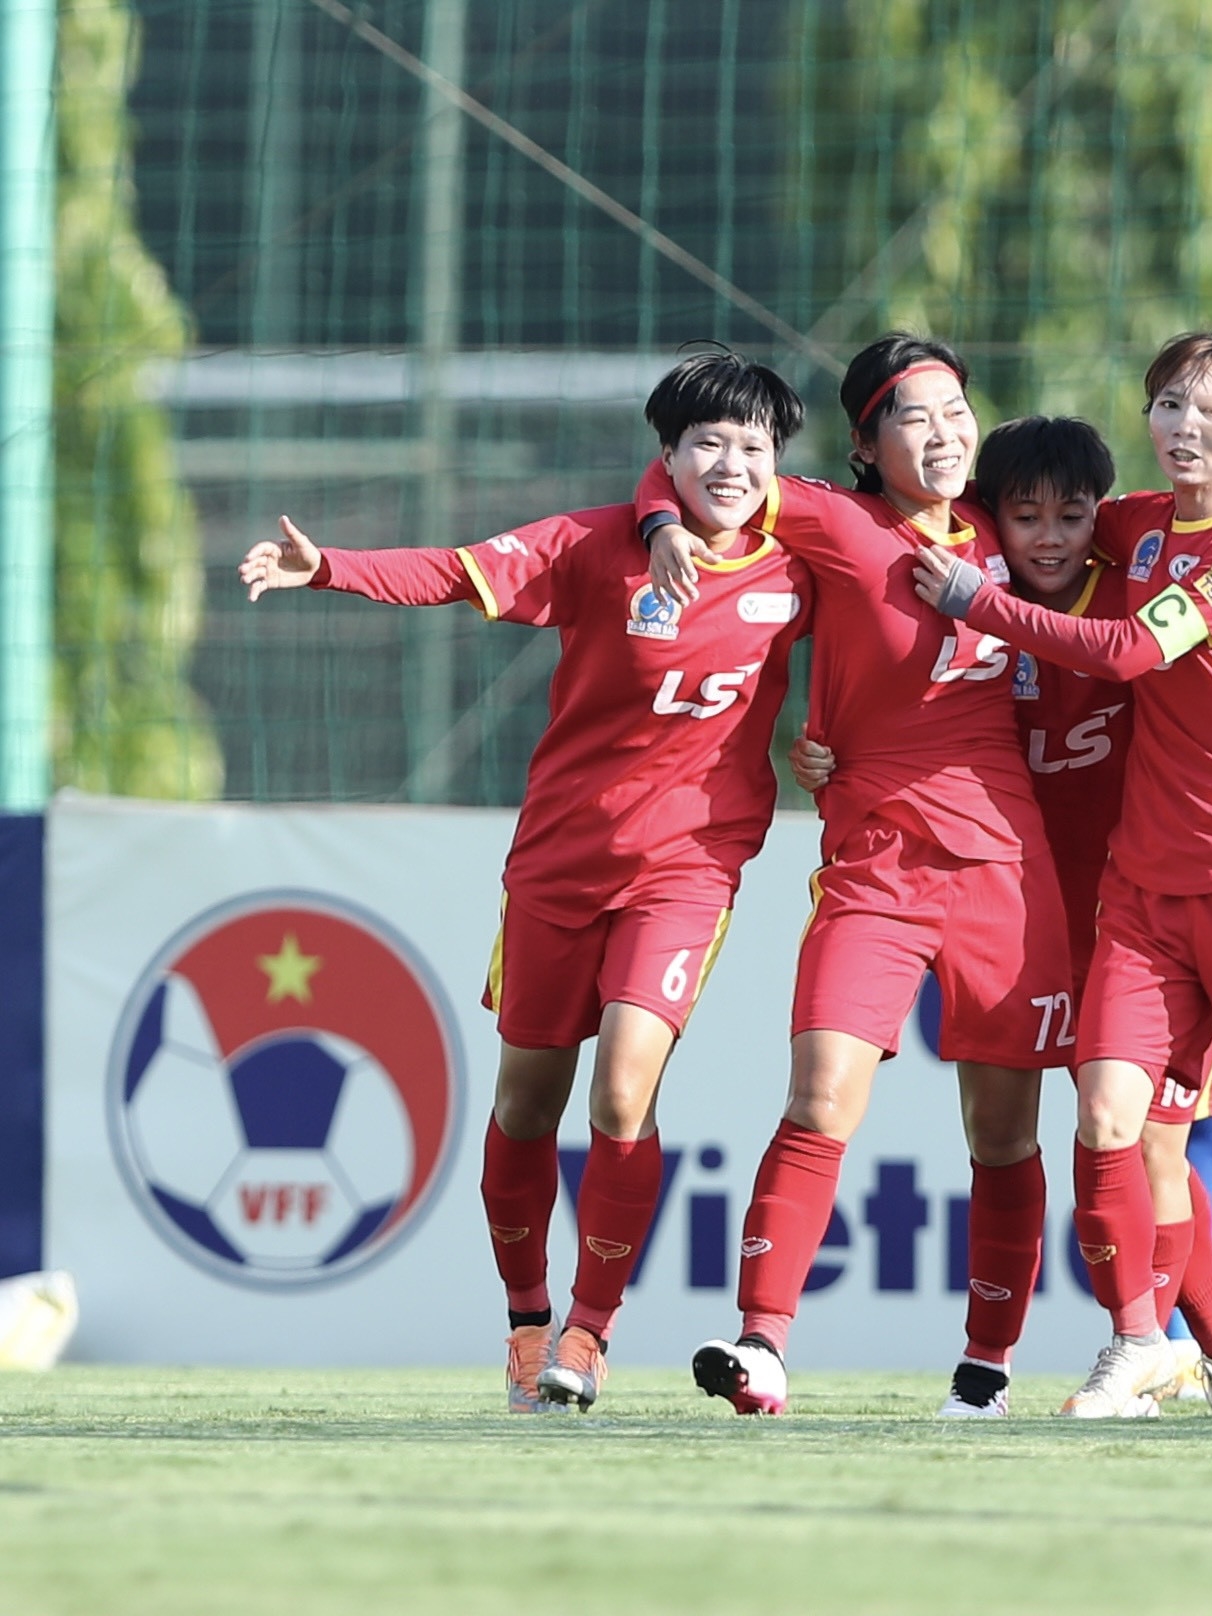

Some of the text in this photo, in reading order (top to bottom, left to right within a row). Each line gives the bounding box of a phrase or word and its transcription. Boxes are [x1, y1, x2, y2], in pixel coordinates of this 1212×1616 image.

[1148, 594, 1187, 628] C
[930, 634, 1009, 681] LS
[653, 668, 752, 720] LS
[1028, 712, 1115, 774] LS
[661, 949, 690, 1001] 6
[1030, 991, 1076, 1051] 72
[239, 1183, 330, 1224] VFF
